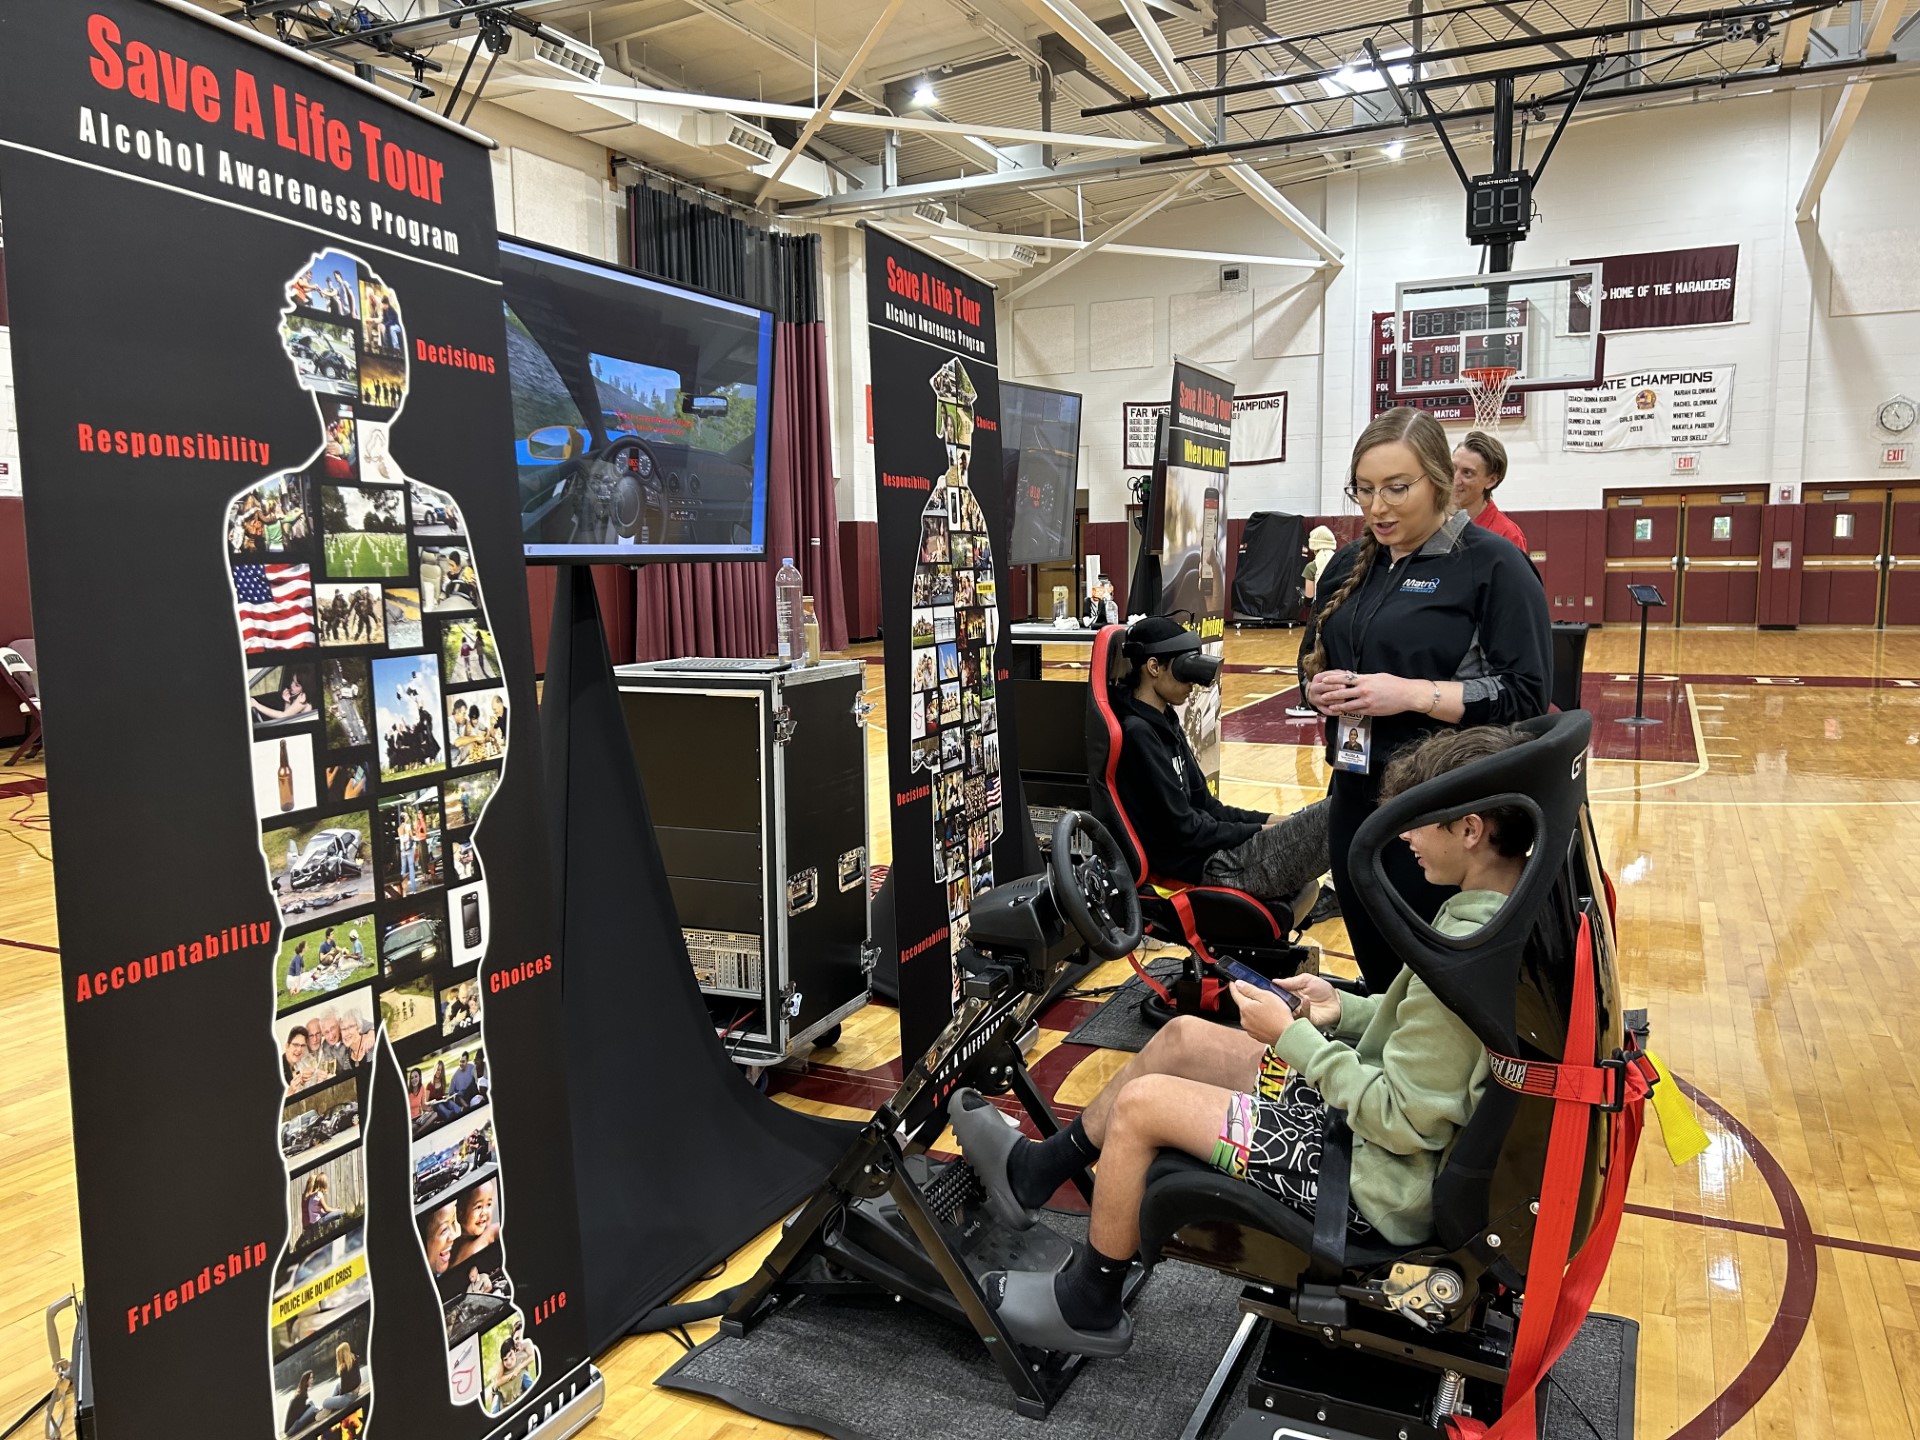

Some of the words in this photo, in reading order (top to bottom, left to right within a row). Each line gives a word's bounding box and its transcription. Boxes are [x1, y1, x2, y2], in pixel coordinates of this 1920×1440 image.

[87, 13, 221, 123] Save
[234, 68, 265, 140] A
[272, 84, 352, 171] Life
[359, 120, 445, 205] Tour
[79, 106, 205, 176] Alcohol
[218, 150, 362, 226] Awareness
[371, 202, 460, 257] Program
[886, 256, 919, 302] Save
[922, 272, 930, 307] A
[931, 276, 953, 315] Life
[954, 287, 980, 327] Tour
[1610, 286, 1634, 300] HOME
[1637, 285, 1650, 297] OF
[1653, 283, 1672, 296] THE
[1675, 278, 1732, 294] MARAUDERS
[885, 302, 916, 329] Alcohol
[918, 314, 956, 343] Awareness
[958, 329, 985, 354] Program
[1482, 333, 1520, 348] GST
[417, 339, 495, 375] Decisions
[1382, 343, 1413, 355] HOE
[1630, 371, 1713, 387] CHAMPIONS
[1179, 381, 1196, 412] Save
[1197, 387, 1202, 414] A
[976, 416, 997, 431] Choices
[1130, 408, 1148, 417] FAR
[1434, 409, 1460, 418] MATCH
[78, 423, 270, 466] Responsibility
[1184, 439, 1201, 466] When
[1202, 445, 1213, 467] you
[1213, 446, 1226, 468] mix
[1886, 449, 1904, 461] EXIT
[1678, 457, 1694, 468] EXIT
[883, 472, 931, 491] Responsibility
[1402, 577, 1440, 588] Matrix
[998, 668, 1009, 681] Life
[897, 784, 930, 807] Decisions
[901, 926, 949, 964] Accountability
[77, 920, 271, 1003] Accountability
[490, 954, 552, 994] Choices
[127, 1241, 267, 1335] Friendship
[280, 1295, 301, 1318] POLICE
[301, 1286, 314, 1305] LINE
[314, 1281, 323, 1298] DO
[323, 1274, 335, 1292] NOT
[335, 1265, 352, 1286] CROSS
[534, 1291, 567, 1325] Life
